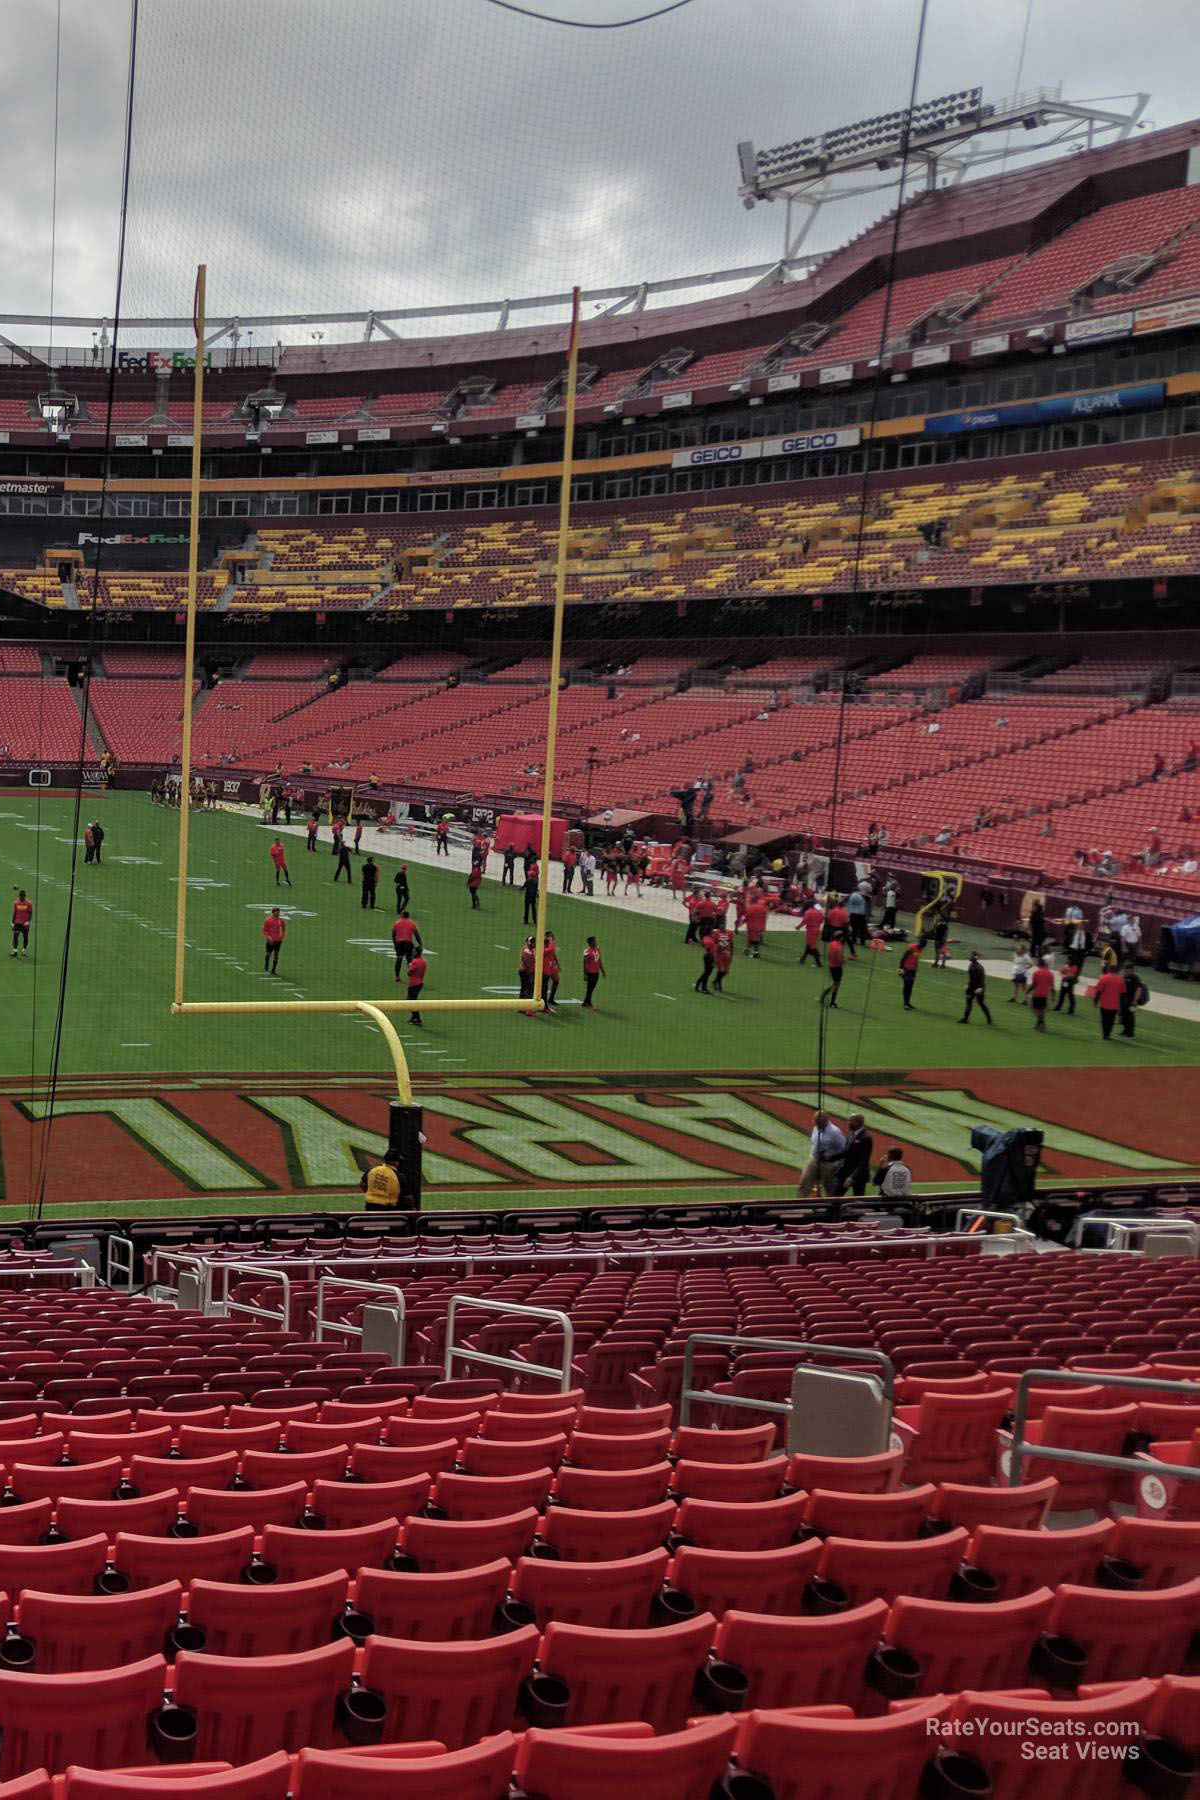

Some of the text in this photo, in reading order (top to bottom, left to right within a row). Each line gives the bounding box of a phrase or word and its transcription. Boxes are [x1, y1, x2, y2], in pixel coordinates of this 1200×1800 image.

[119, 352, 212, 368] FedExFied
[1071, 393, 1122, 413] AQUAFINA
[781, 433, 837, 453] GEICO
[691, 446, 741, 464] GEICO
[223, 781, 240, 793] 1937
